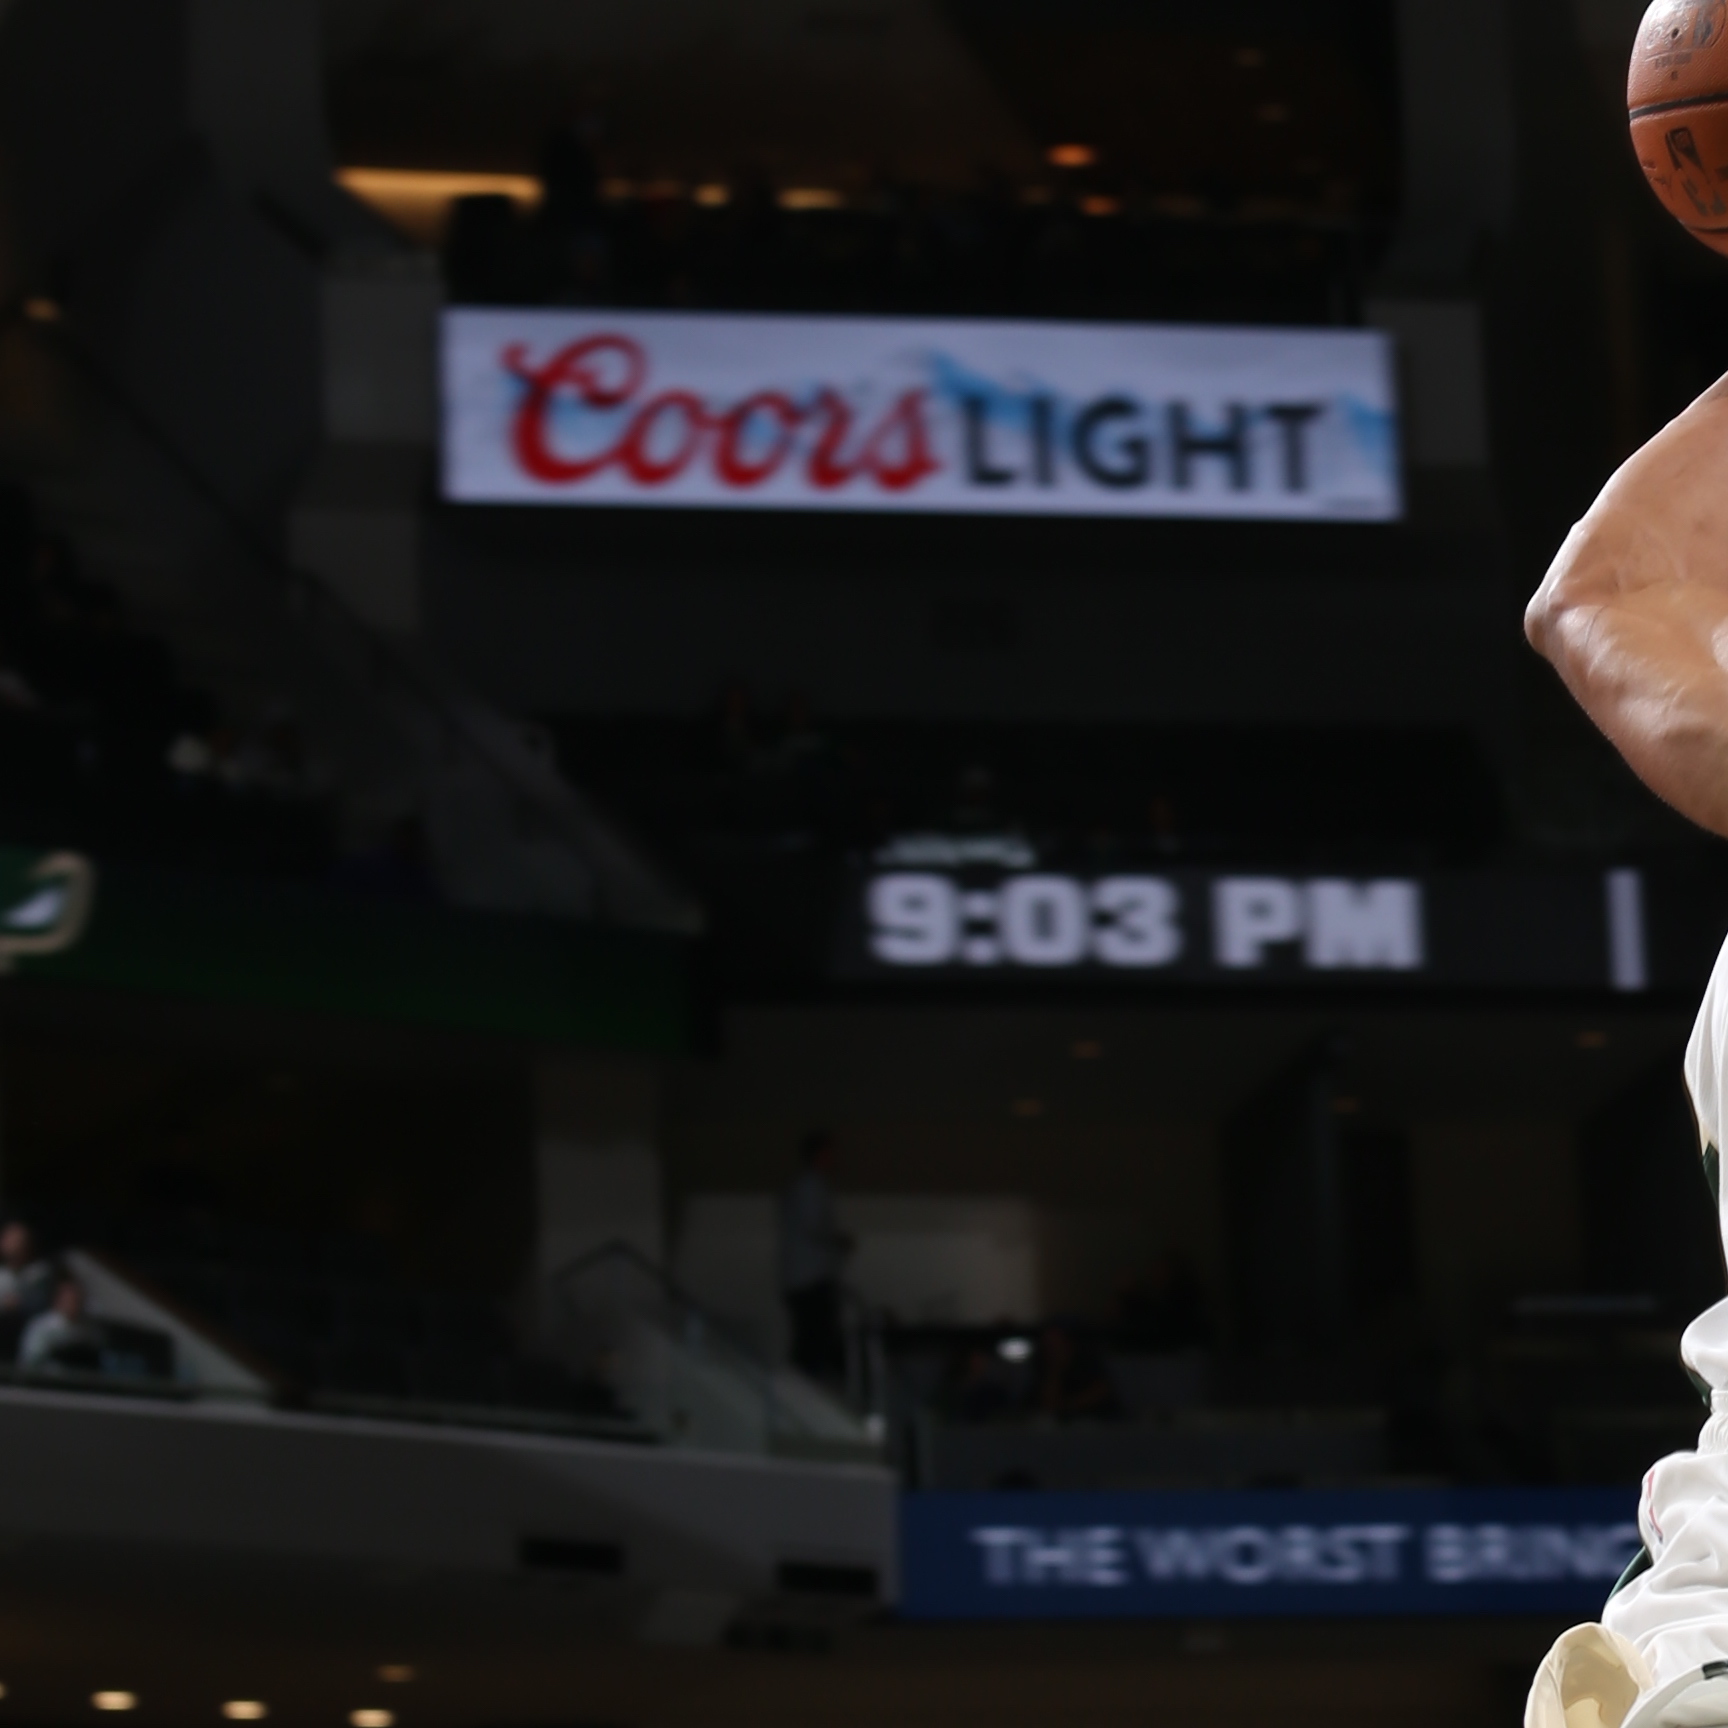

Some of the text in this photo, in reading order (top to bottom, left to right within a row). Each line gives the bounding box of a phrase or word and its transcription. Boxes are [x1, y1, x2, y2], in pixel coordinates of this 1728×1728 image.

[500, 333, 1333, 493] Coors LIGHT
[868, 872, 1421, 969] 9:03 PM
[969, 1522, 1643, 1586] THE WORST BRING
